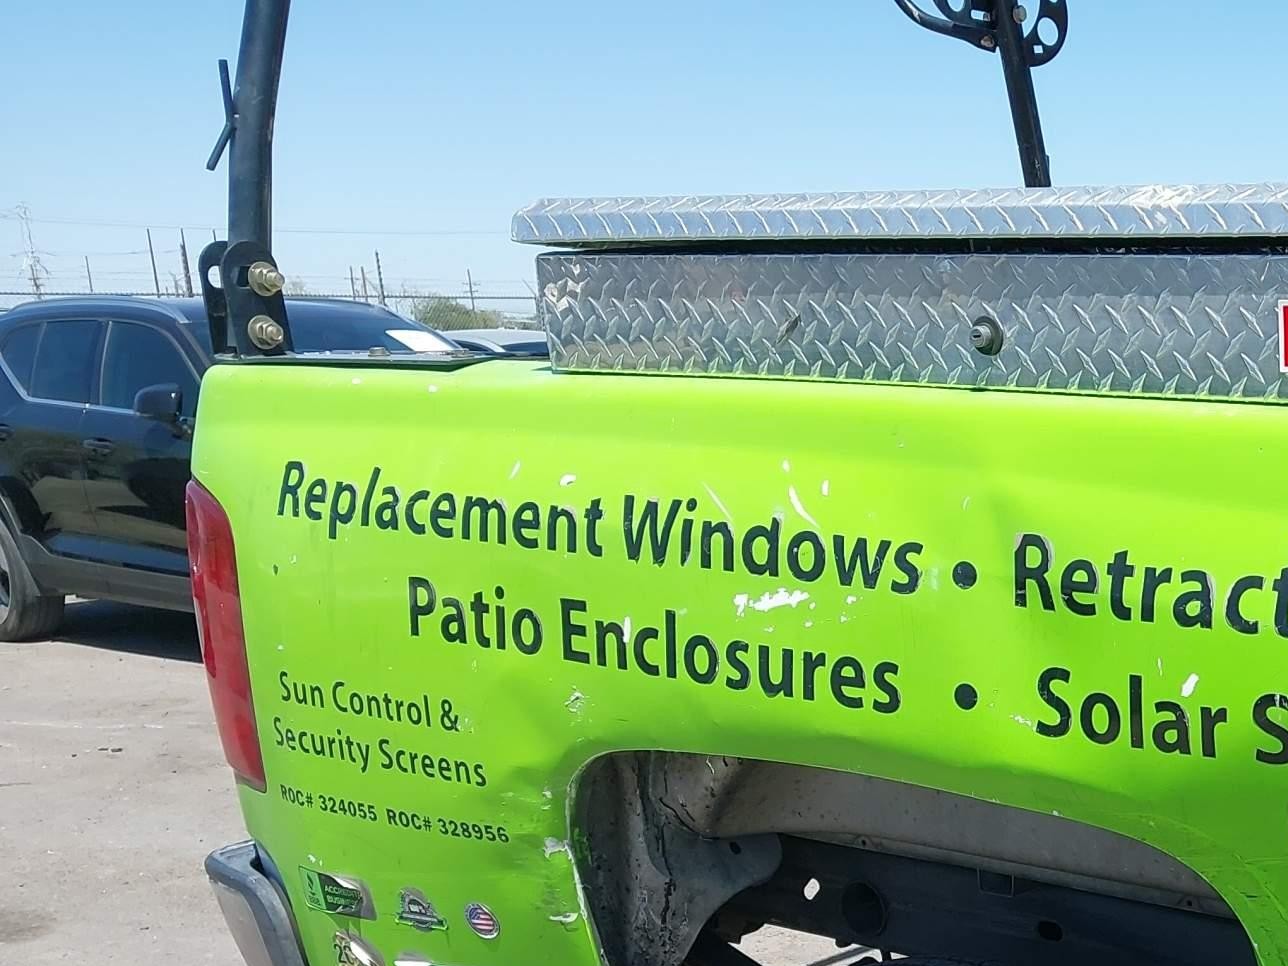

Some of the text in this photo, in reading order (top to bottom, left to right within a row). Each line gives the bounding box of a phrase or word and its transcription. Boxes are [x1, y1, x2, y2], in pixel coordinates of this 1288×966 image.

[277, 460, 925, 595] Replacement Windows
[408, 575, 902, 715] Patio Enclosures
[279, 671, 460, 732] Sun Control &
[1036, 666, 1229, 759] Solar
[273, 716, 487, 787] Security Screens
[280, 784, 509, 844] ROC# 324055 ROC# 328956
